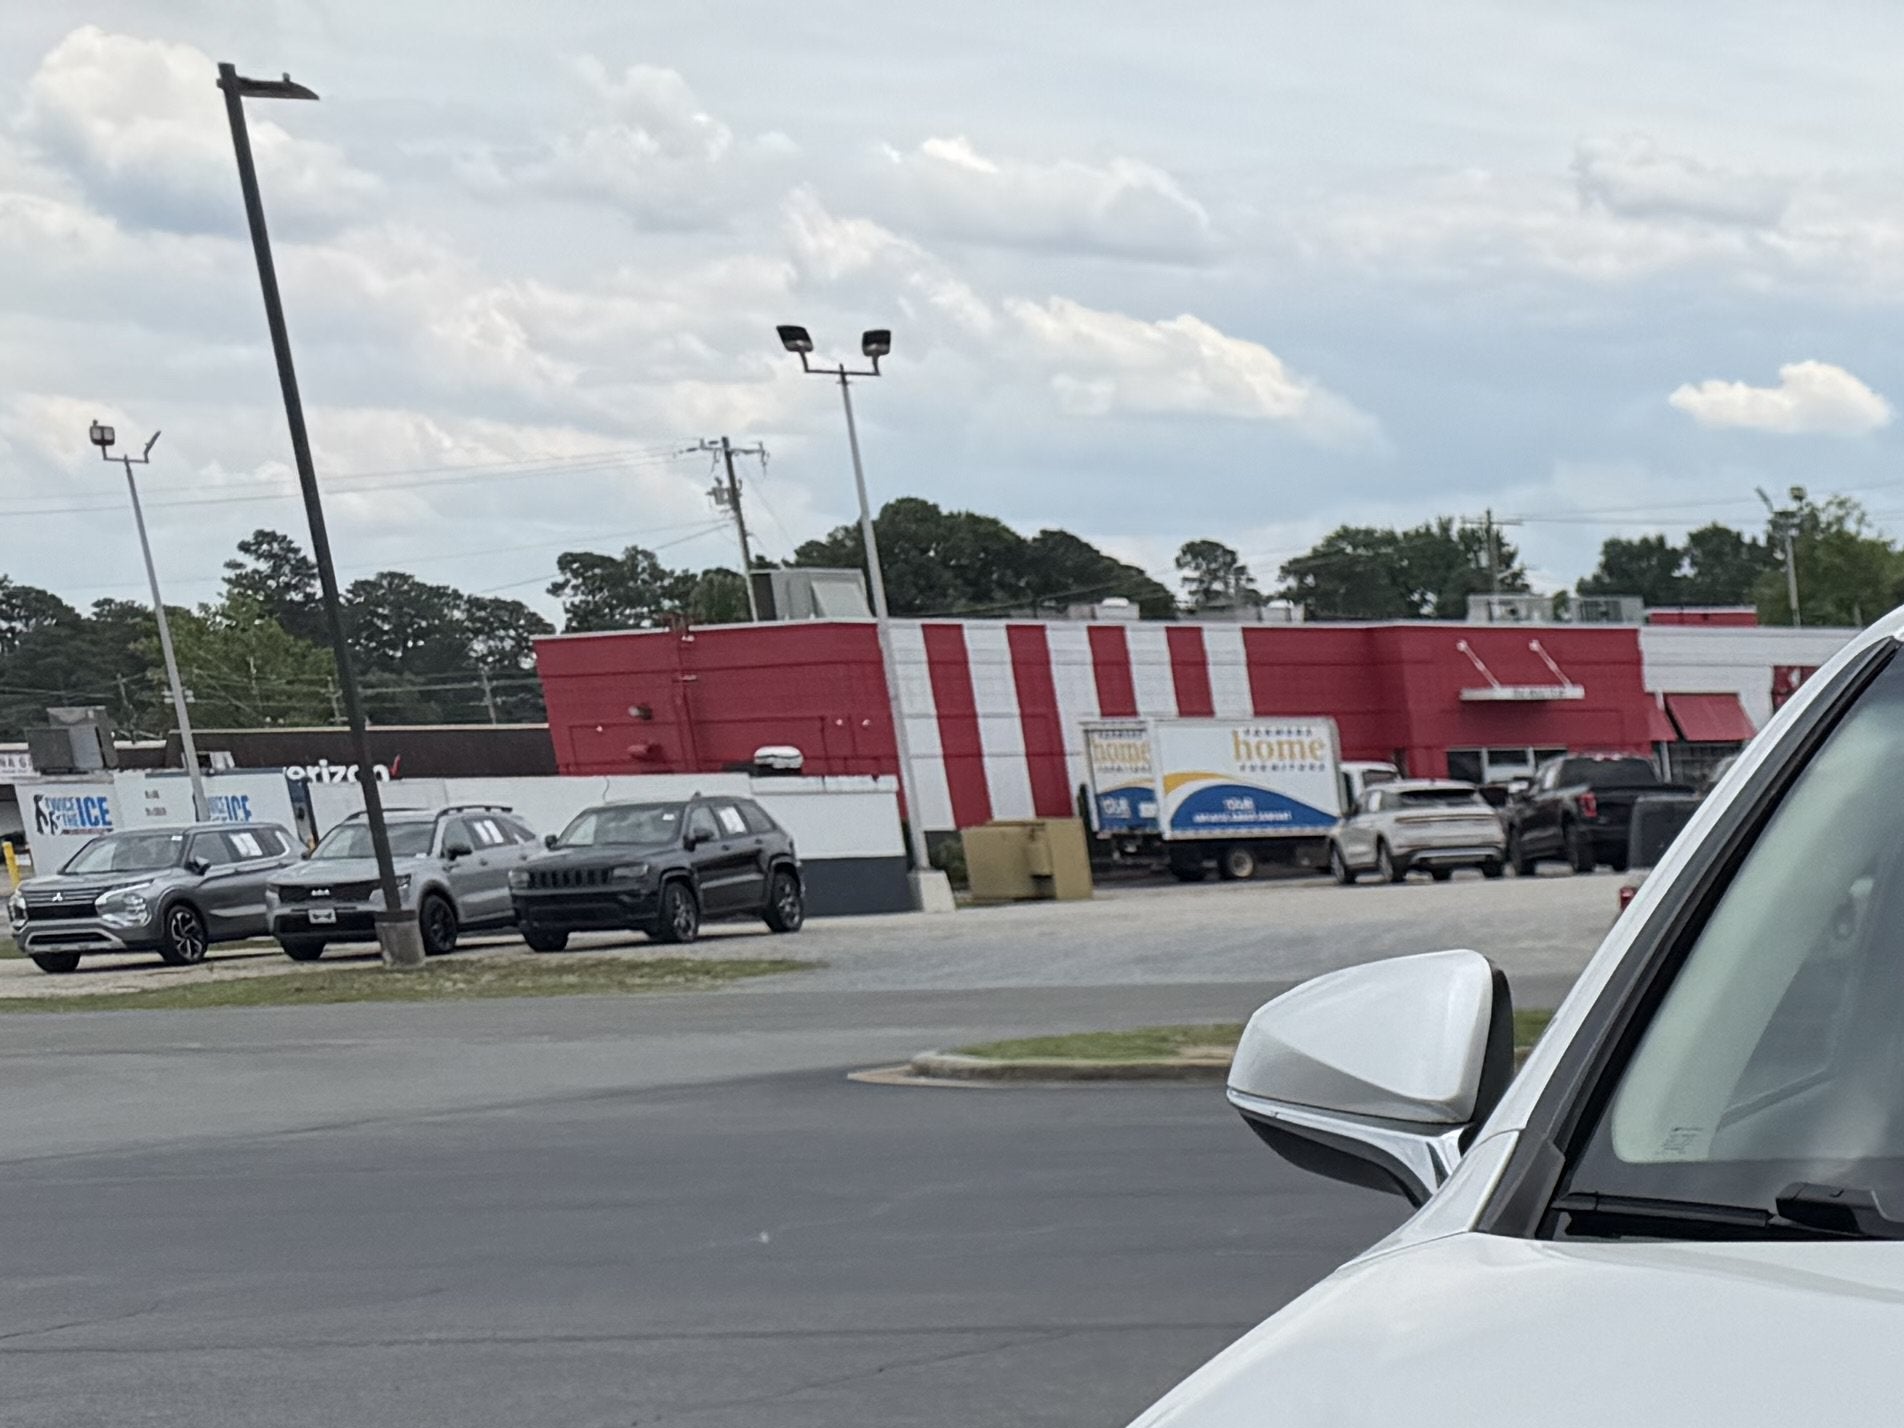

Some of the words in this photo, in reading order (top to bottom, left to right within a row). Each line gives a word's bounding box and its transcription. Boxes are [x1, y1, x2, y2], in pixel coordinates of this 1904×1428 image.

[1232, 730, 1325, 761] home
[282, 759, 390, 784] erizon
[75, 796, 113, 827] ICE
